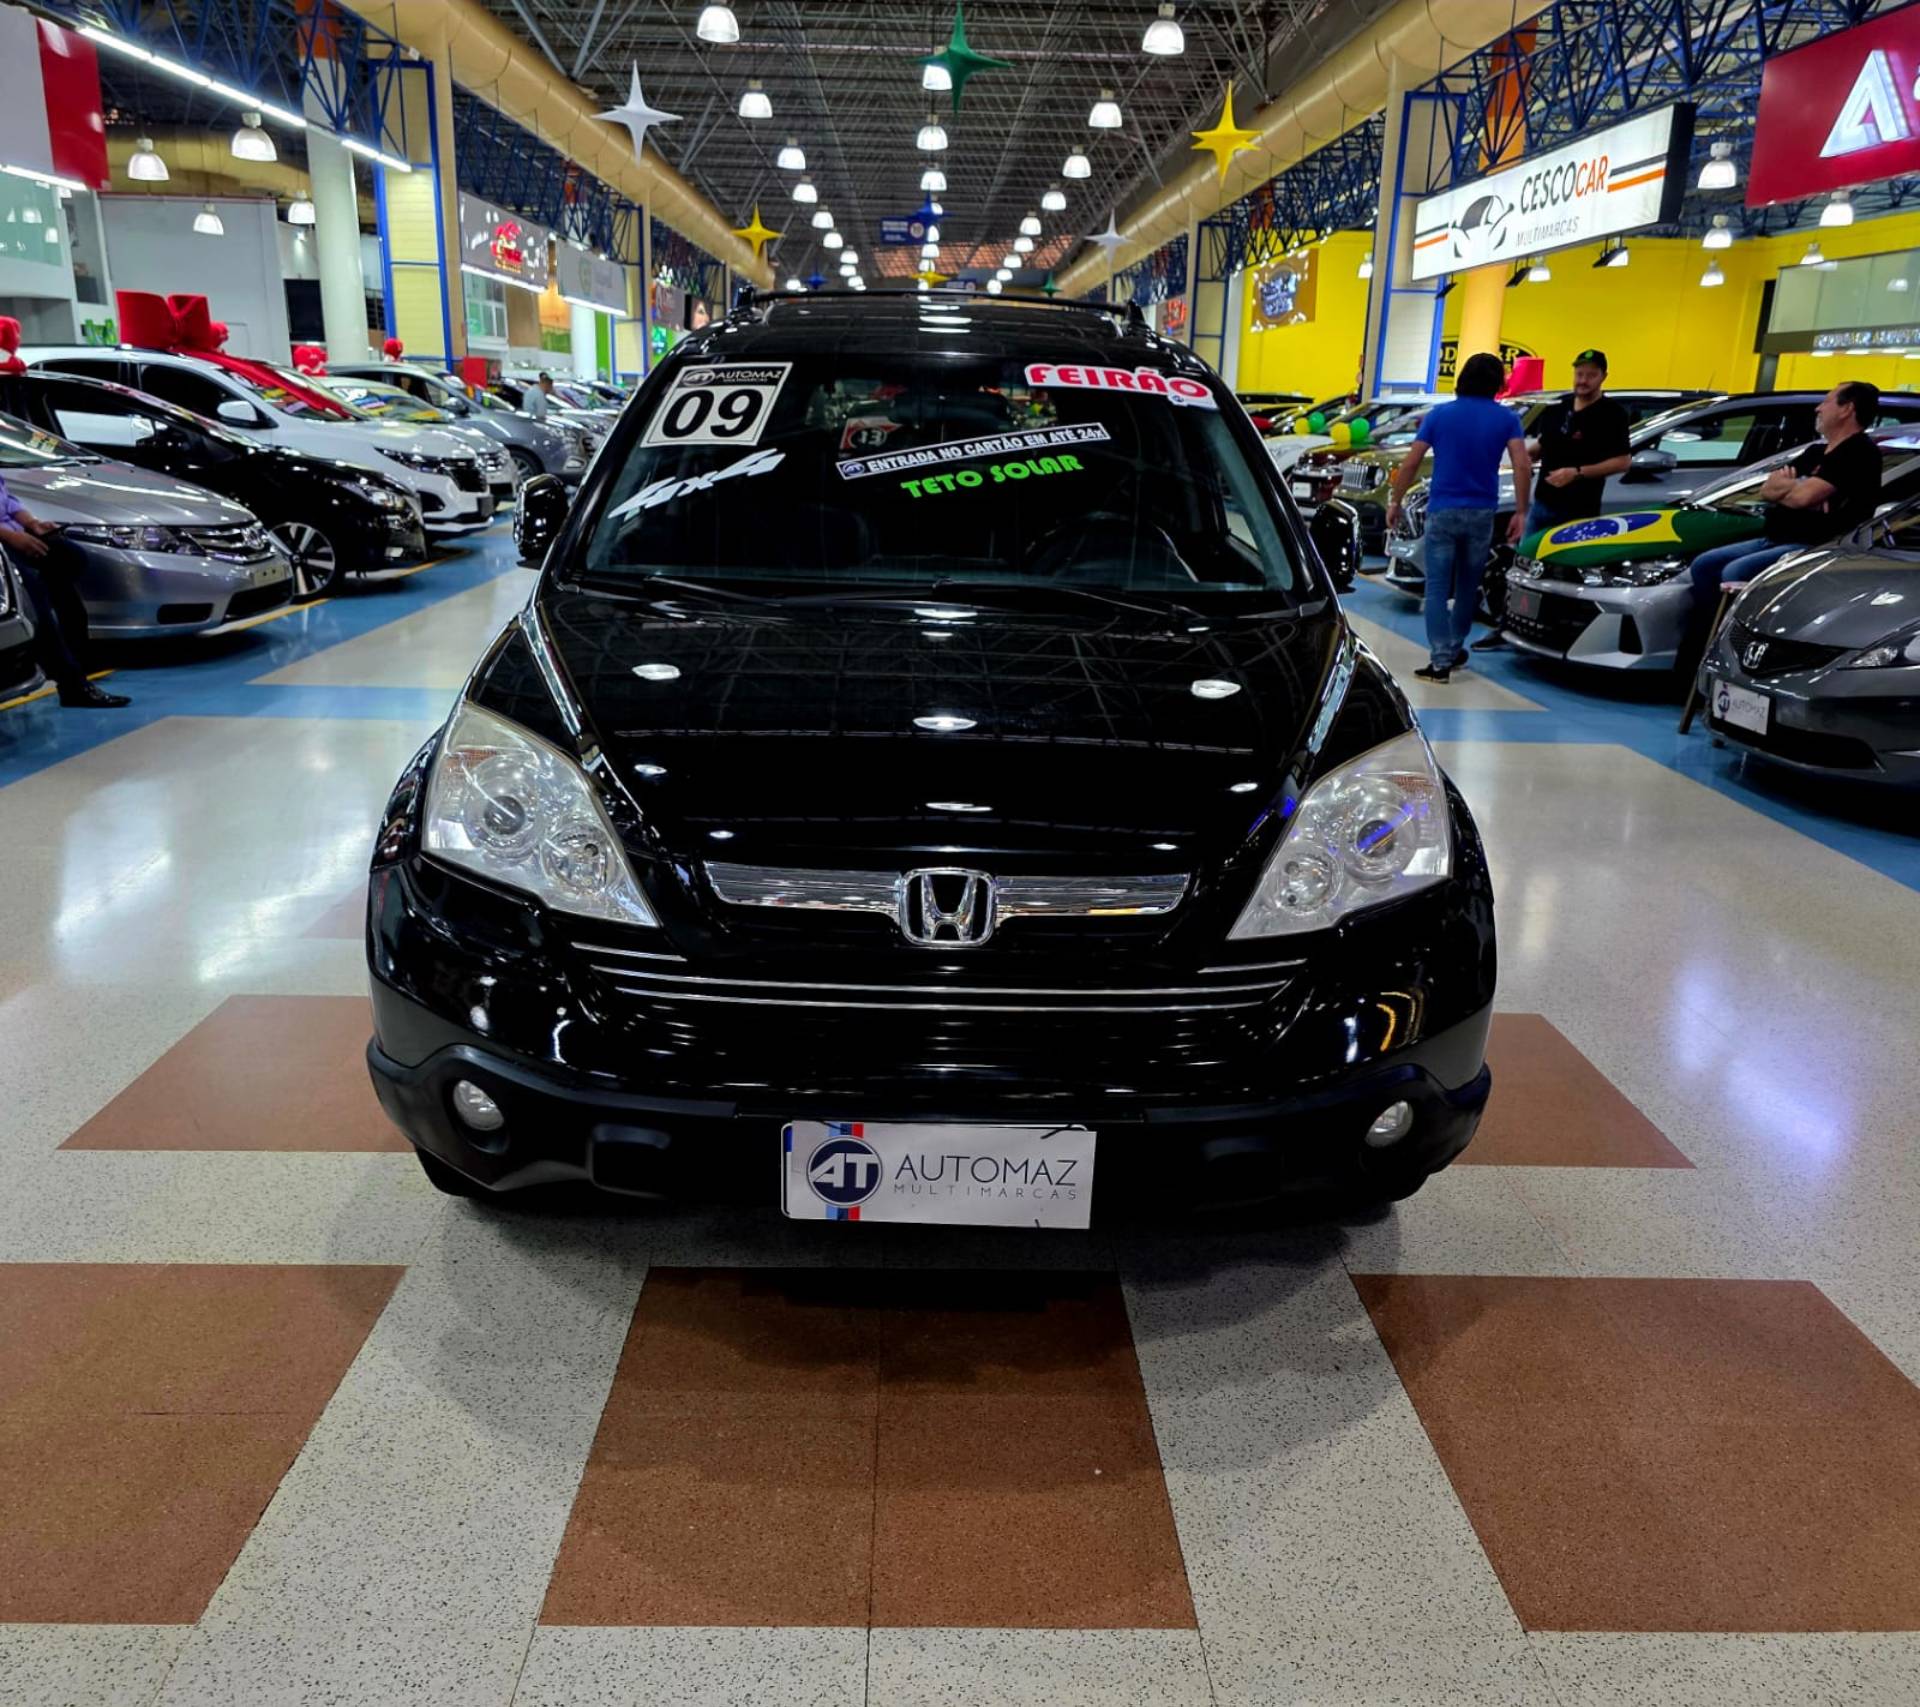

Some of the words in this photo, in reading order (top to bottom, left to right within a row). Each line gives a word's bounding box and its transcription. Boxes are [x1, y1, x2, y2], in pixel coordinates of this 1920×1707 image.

[1521, 155, 1608, 215] CESCOCAR
[716, 370, 783, 380] AUTOMAZ
[1029, 366, 1208, 398] FEIRÃO
[662, 389, 763, 439] 09
[866, 450, 938, 473] ENTRADA
[938, 446, 962, 460] NO
[963, 435, 1024, 456] CARTÃO
[1024, 432, 1047, 447] EM
[1050, 428, 1078, 443] ATÉ
[900, 470, 984, 498] TETO
[989, 454, 1085, 483] SOLAR
[894, 1153, 1079, 1187] AUTOMAZ
[893, 1184, 1078, 1201] MULTIMARCAS
